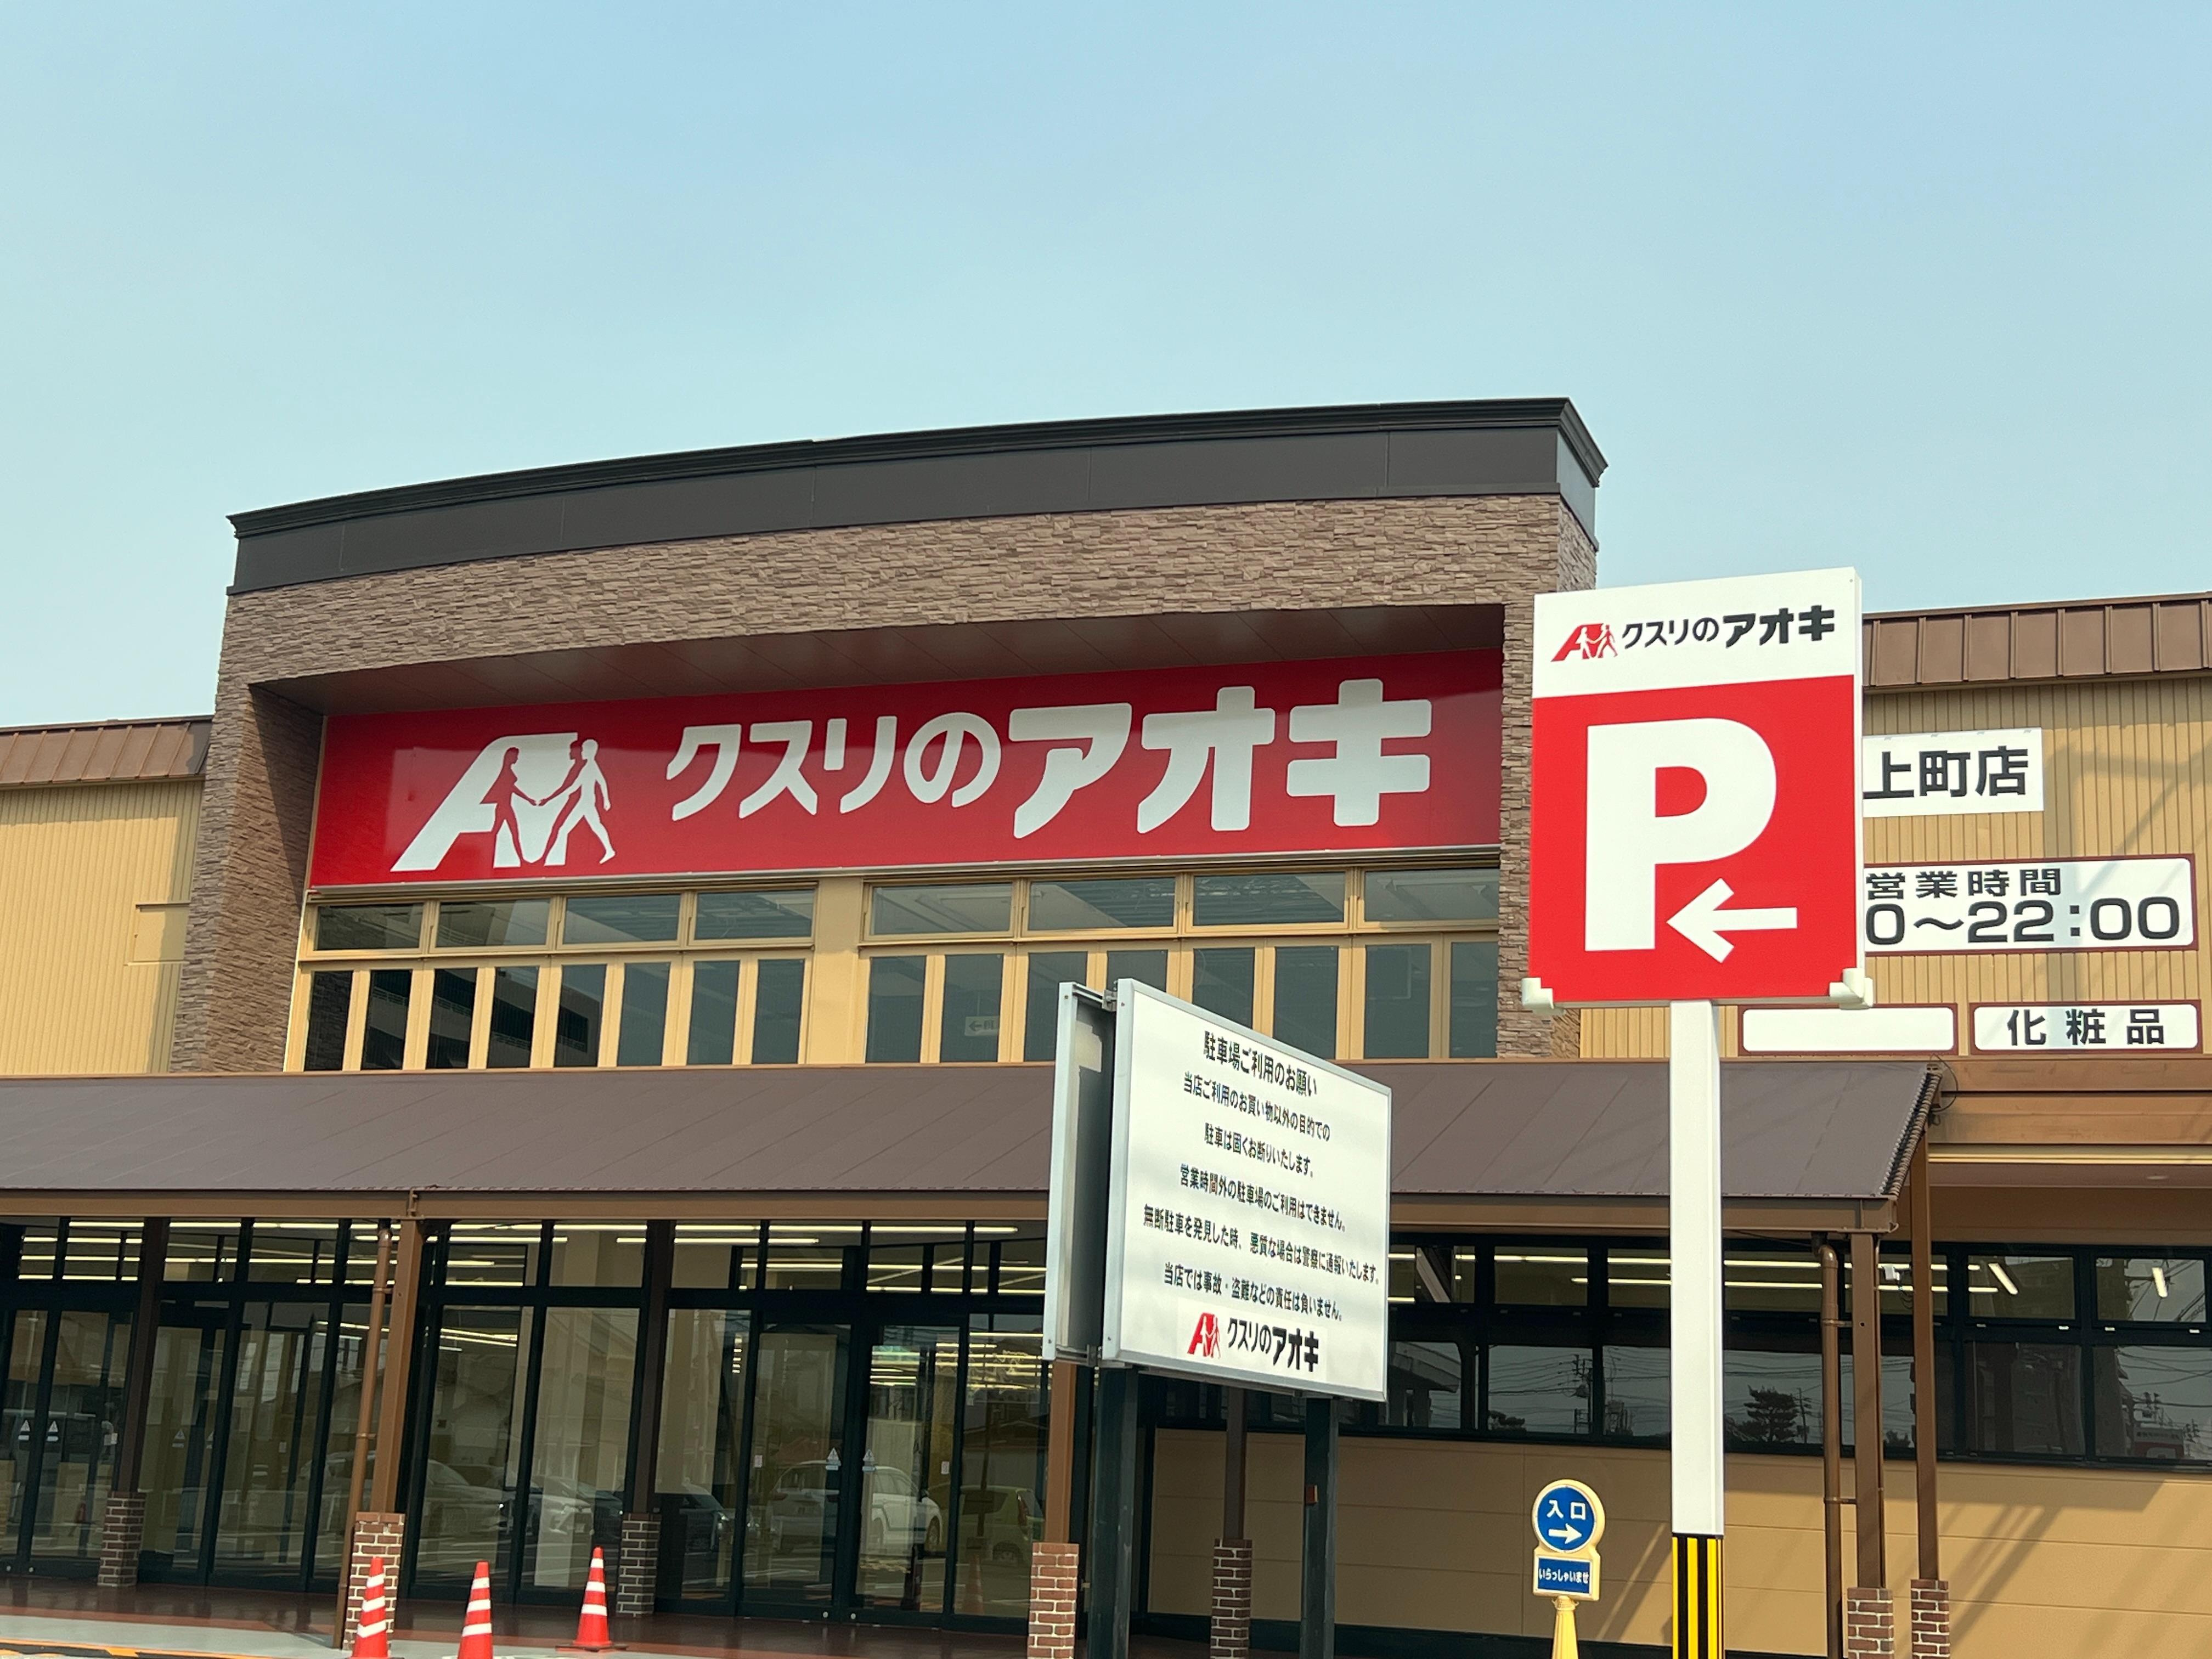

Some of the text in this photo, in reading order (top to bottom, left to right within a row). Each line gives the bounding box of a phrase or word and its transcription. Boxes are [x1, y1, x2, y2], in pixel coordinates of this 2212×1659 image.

[1622, 605, 1835, 648] クスリのアオキ
[667, 678, 1432, 838] クスリのアオキ
[1863, 746, 2029, 799] 上町店
[1585, 718, 1776, 952] P
[1866, 868, 2062, 900] 営業時間
[2007, 1009, 2165, 1046] 化粧品
[1204, 1031, 1317, 1097] 駐車場ご利用のお願い
[1184, 1071, 1330, 1142] 当店ご利用のお買い物以外の目的での
[1227, 1317, 1319, 1372] クスリのアオキ
[1547, 1500, 1587, 1520] 入口
[1538, 1568, 1589, 1584] いらっしゃいませ
